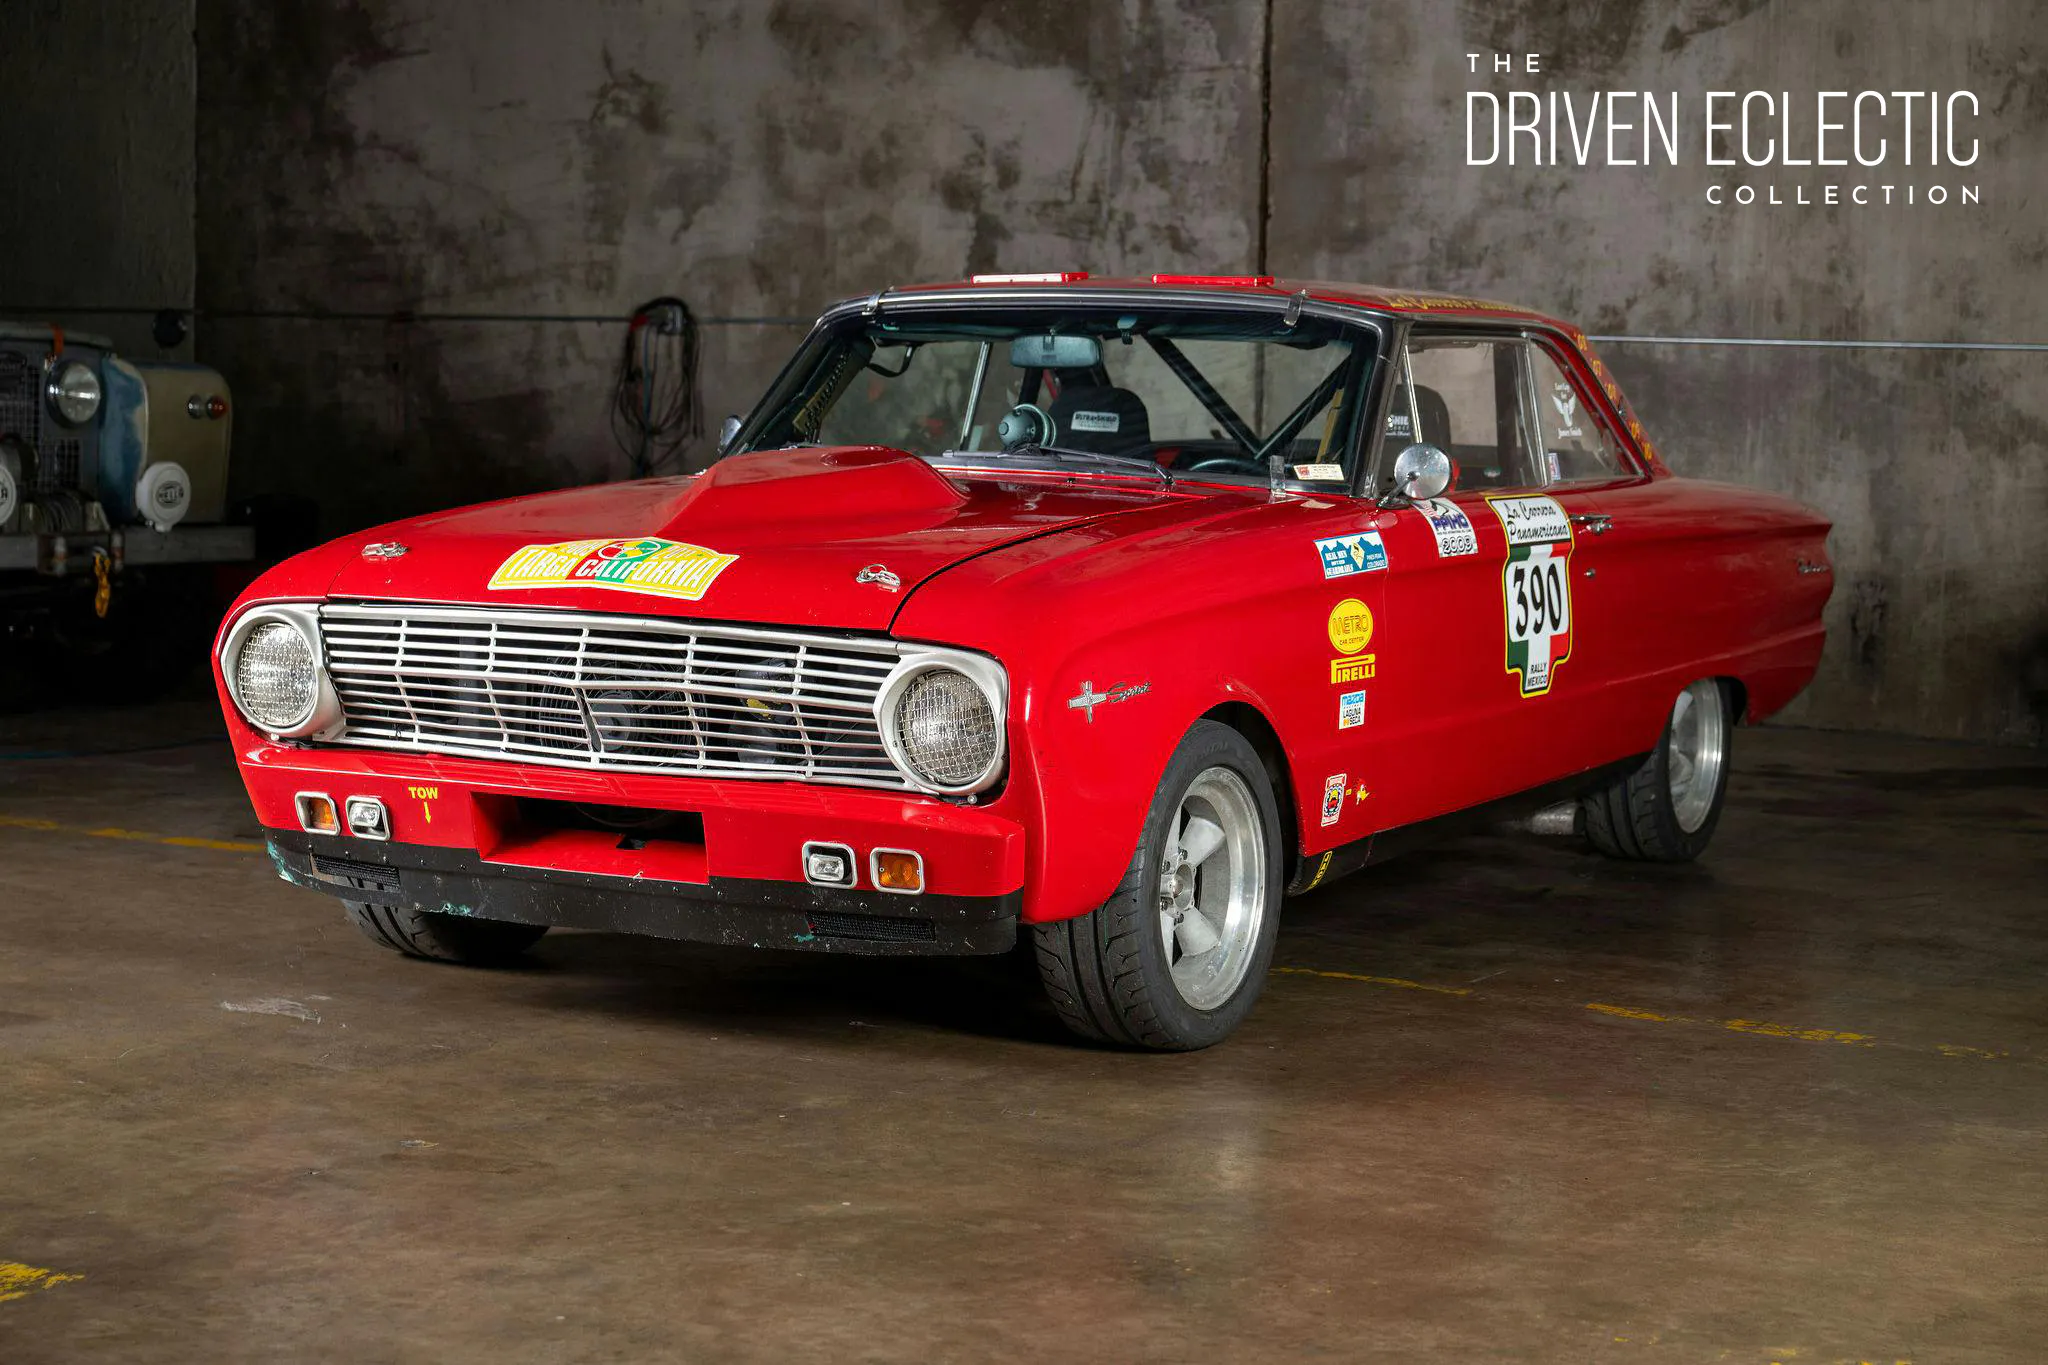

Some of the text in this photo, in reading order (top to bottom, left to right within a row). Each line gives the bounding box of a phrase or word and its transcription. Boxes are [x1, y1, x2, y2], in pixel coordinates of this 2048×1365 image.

[1504, 501, 1557, 521] La Carrera
[1506, 520, 1568, 542] Panamericana
[1441, 535, 1474, 555] 2009
[505, 548, 714, 590] TARGA CALIFORNIA
[1513, 562, 1562, 638] 390
[1331, 613, 1370, 636] METRO
[1331, 653, 1376, 685] PIRELLI
[1530, 662, 1548, 675] RALLY
[1527, 674, 1548, 687] MEXICO
[408, 786, 438, 800] TOW
